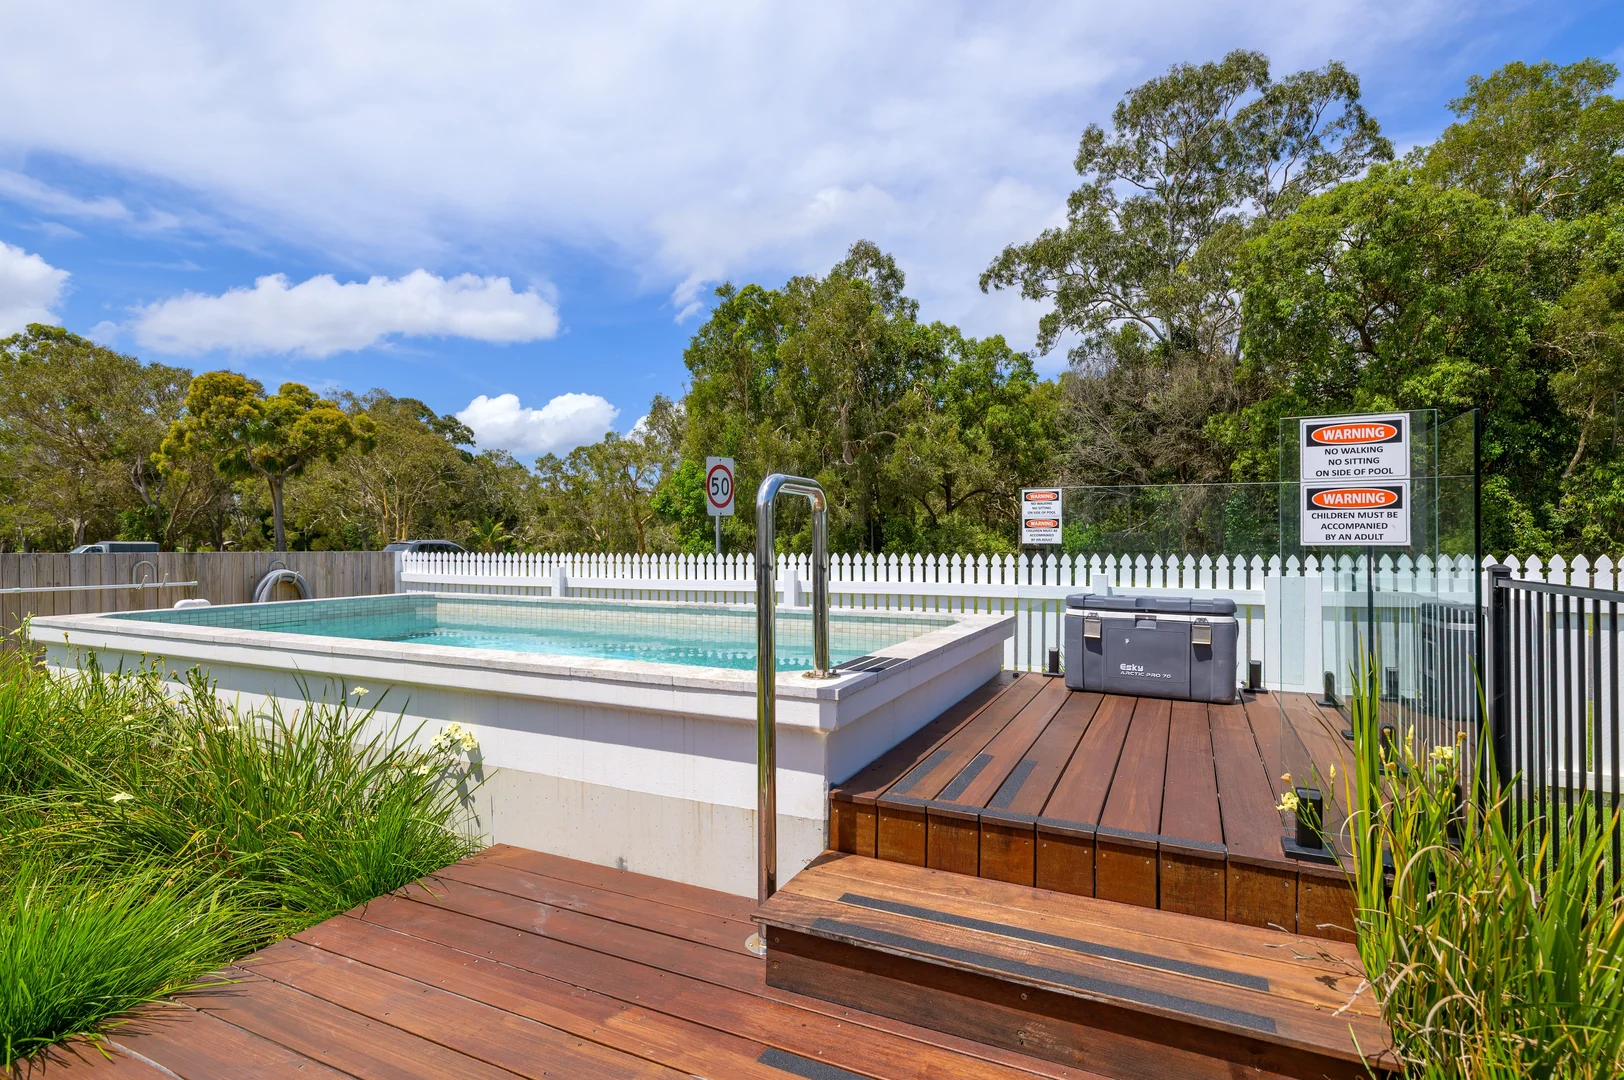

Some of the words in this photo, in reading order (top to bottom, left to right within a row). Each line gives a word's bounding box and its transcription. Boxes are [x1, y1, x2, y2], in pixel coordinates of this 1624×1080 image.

[1323, 427, 1385, 440] WARNING
[1340, 446, 1384, 454] WALKING
[1344, 457, 1380, 465] SITTING
[711, 477, 730, 496] 50
[1323, 492, 1385, 504] WARNING
[1120, 663, 1144, 671] Esky
